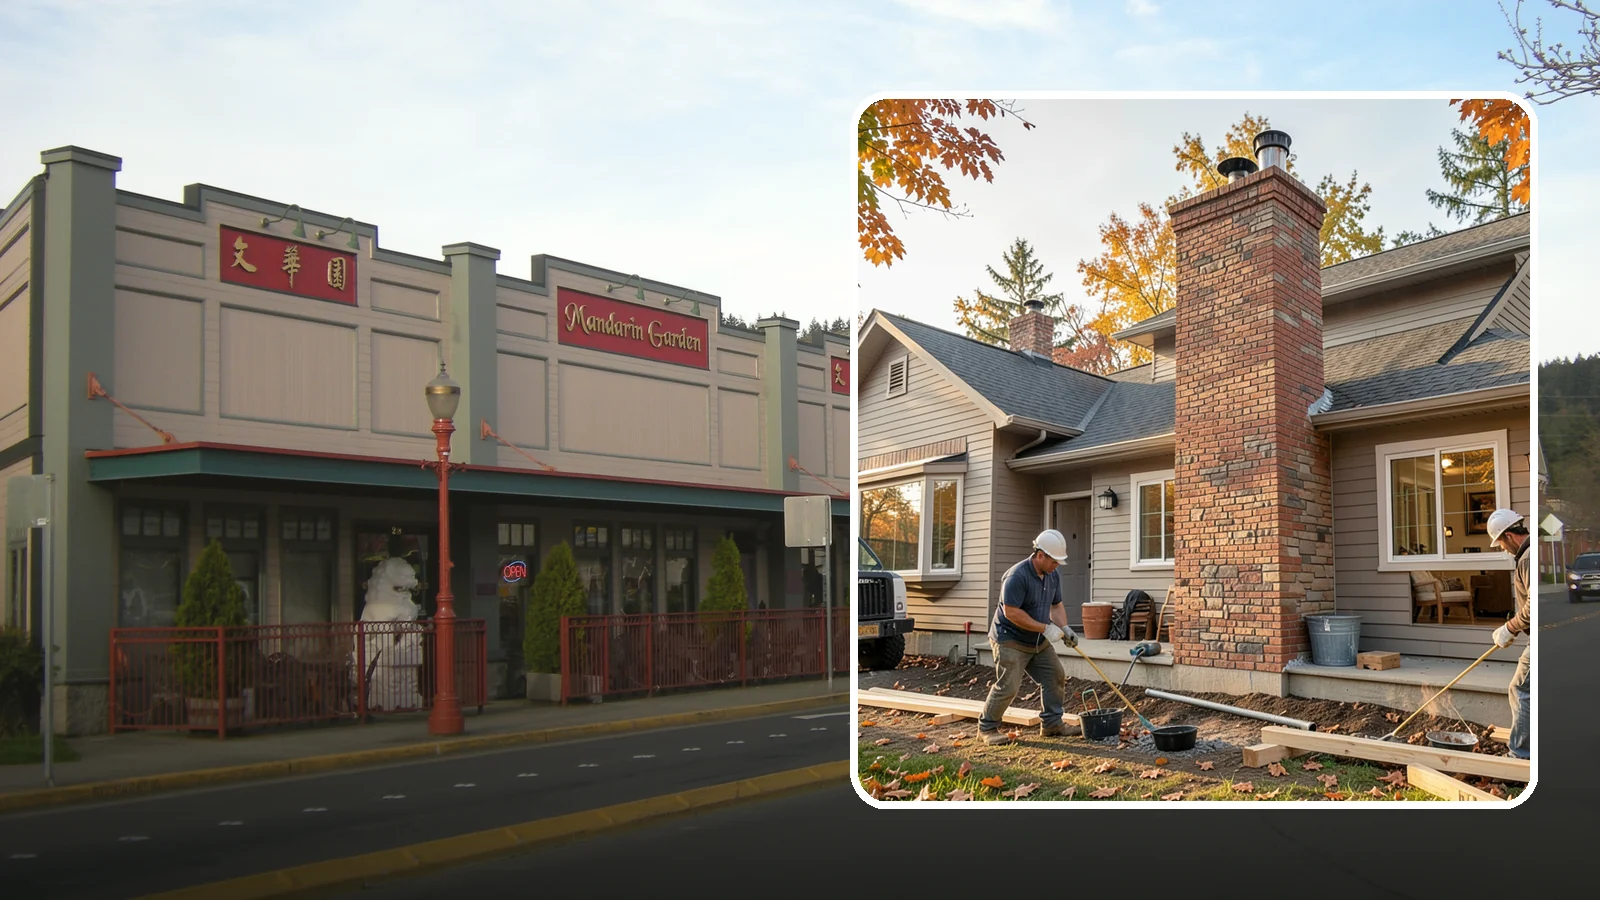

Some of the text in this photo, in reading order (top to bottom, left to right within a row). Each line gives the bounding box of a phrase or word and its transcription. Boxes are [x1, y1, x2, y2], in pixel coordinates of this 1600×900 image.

[231, 236, 346, 291] 文華園
[565, 302, 702, 352] Mandarin Garden
[503, 565, 527, 578] OPEN
